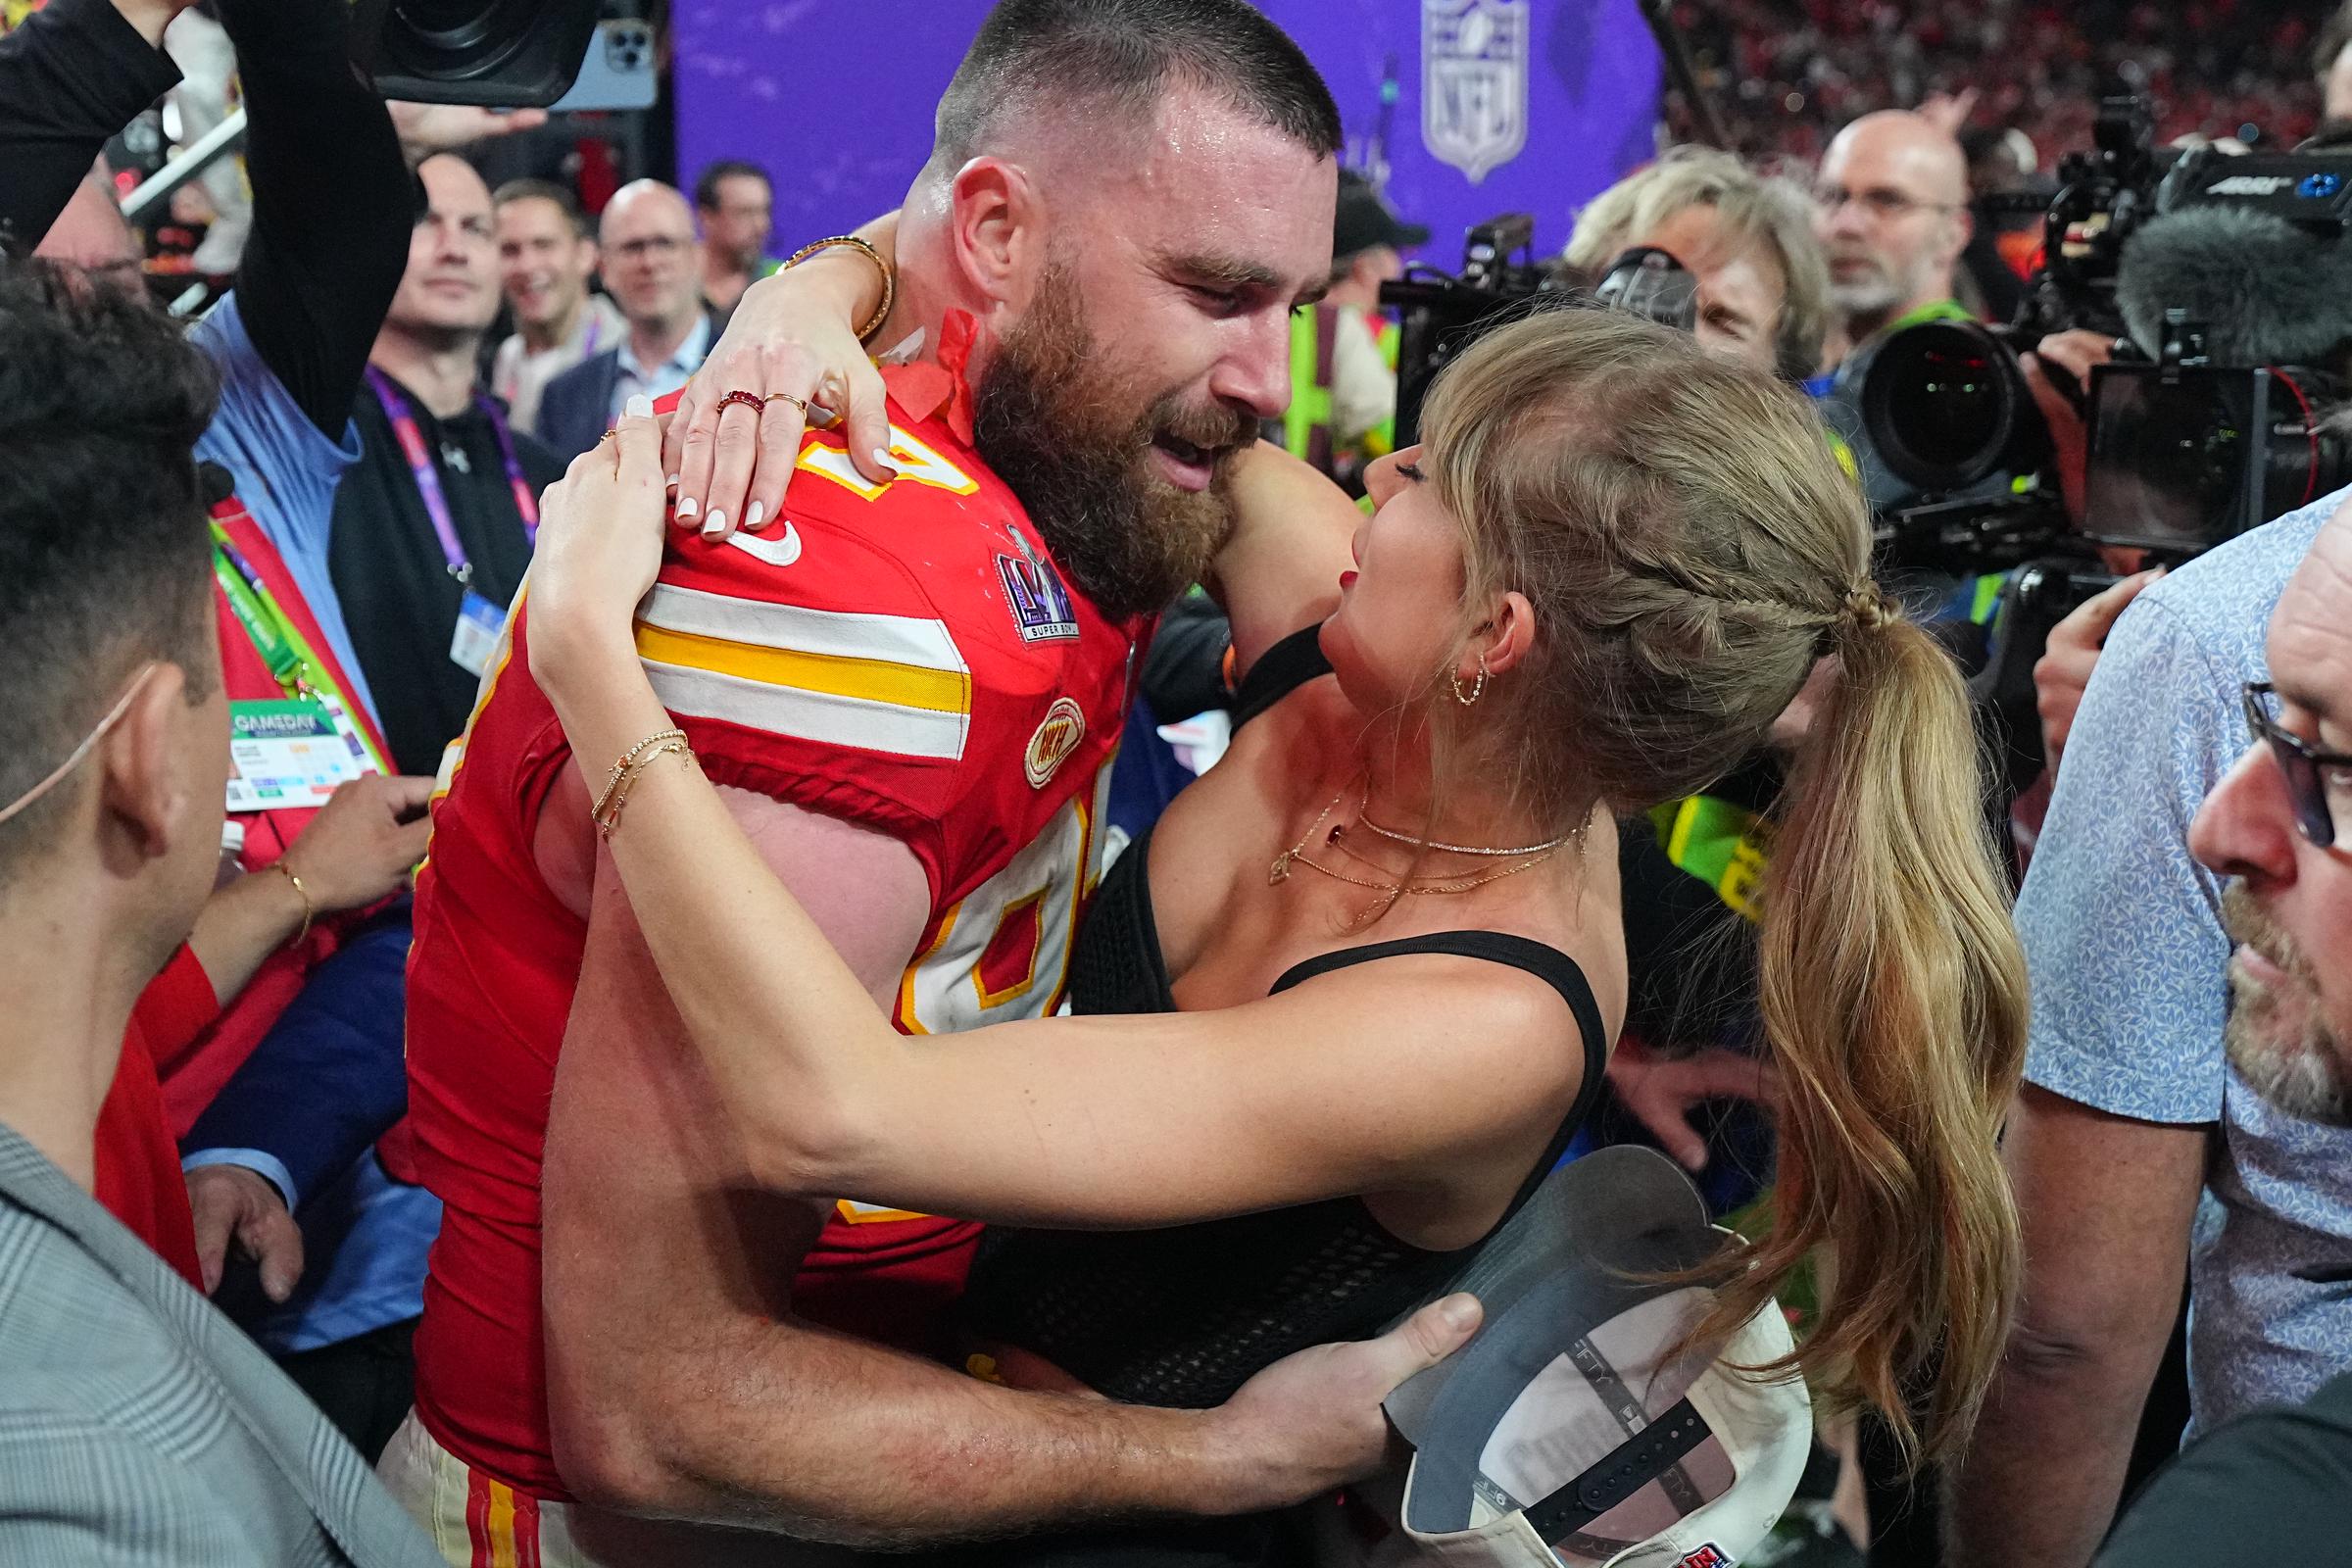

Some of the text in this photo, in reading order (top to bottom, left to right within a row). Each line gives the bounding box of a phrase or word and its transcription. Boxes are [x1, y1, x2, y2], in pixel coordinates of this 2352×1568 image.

[1430, 61, 1516, 144] NFL
[1031, 625, 1058, 637] SUPER
[233, 713, 318, 732] GAMEDAY
